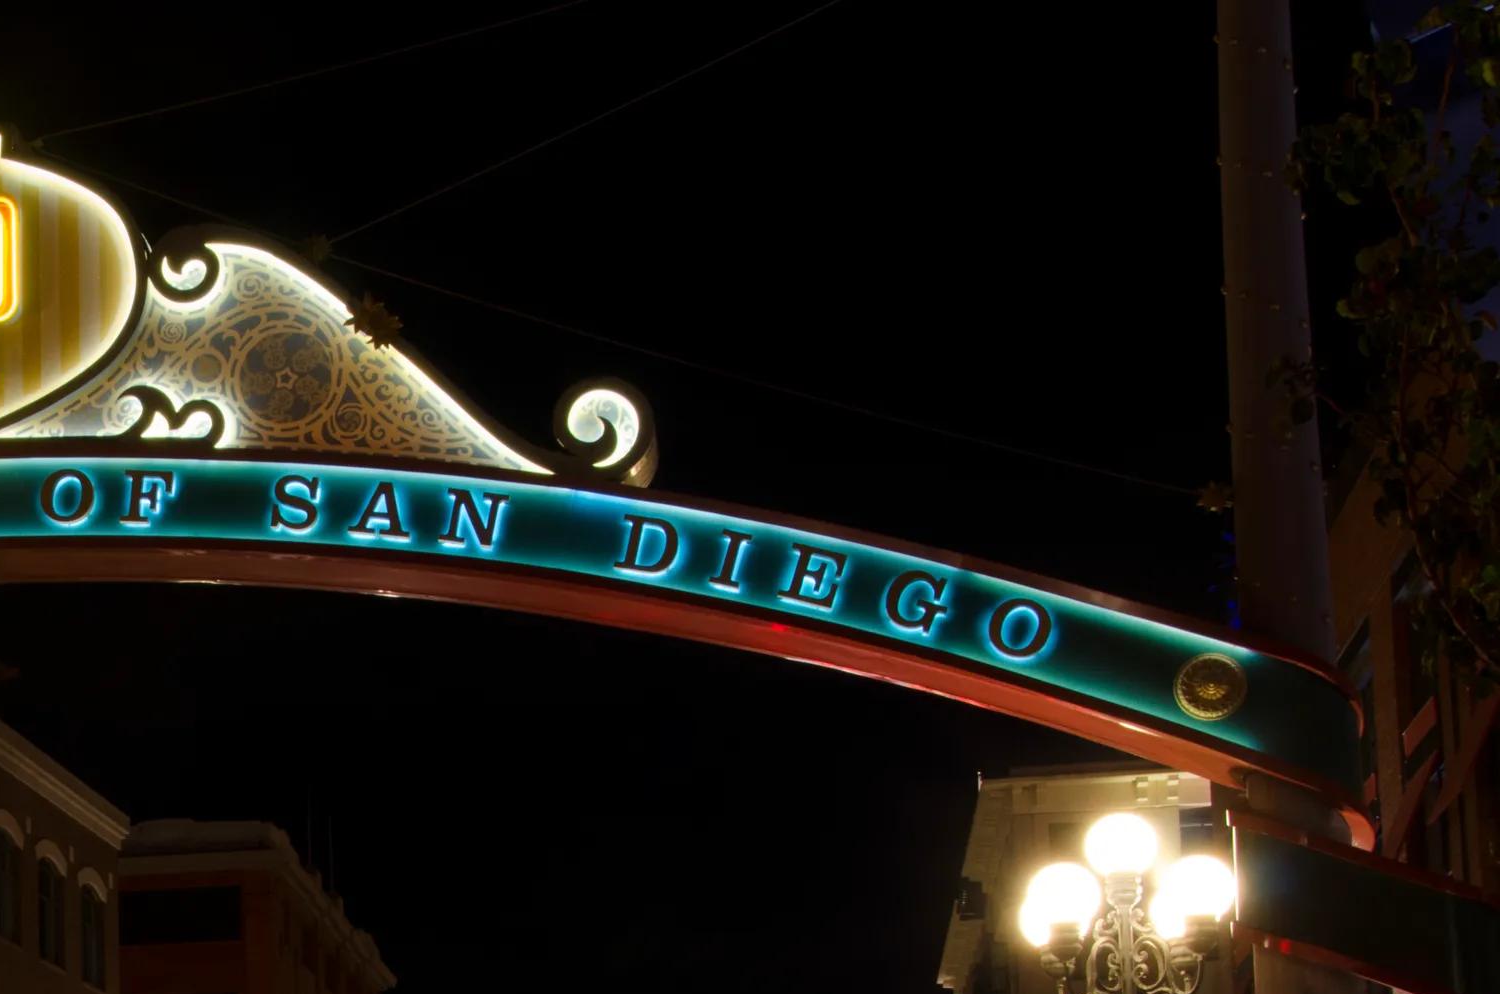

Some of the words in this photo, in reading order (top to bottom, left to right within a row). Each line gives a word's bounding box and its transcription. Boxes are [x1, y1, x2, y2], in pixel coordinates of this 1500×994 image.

[39, 467, 174, 527] OF
[270, 474, 510, 549] SAN
[613, 513, 1053, 660] DIEGO
